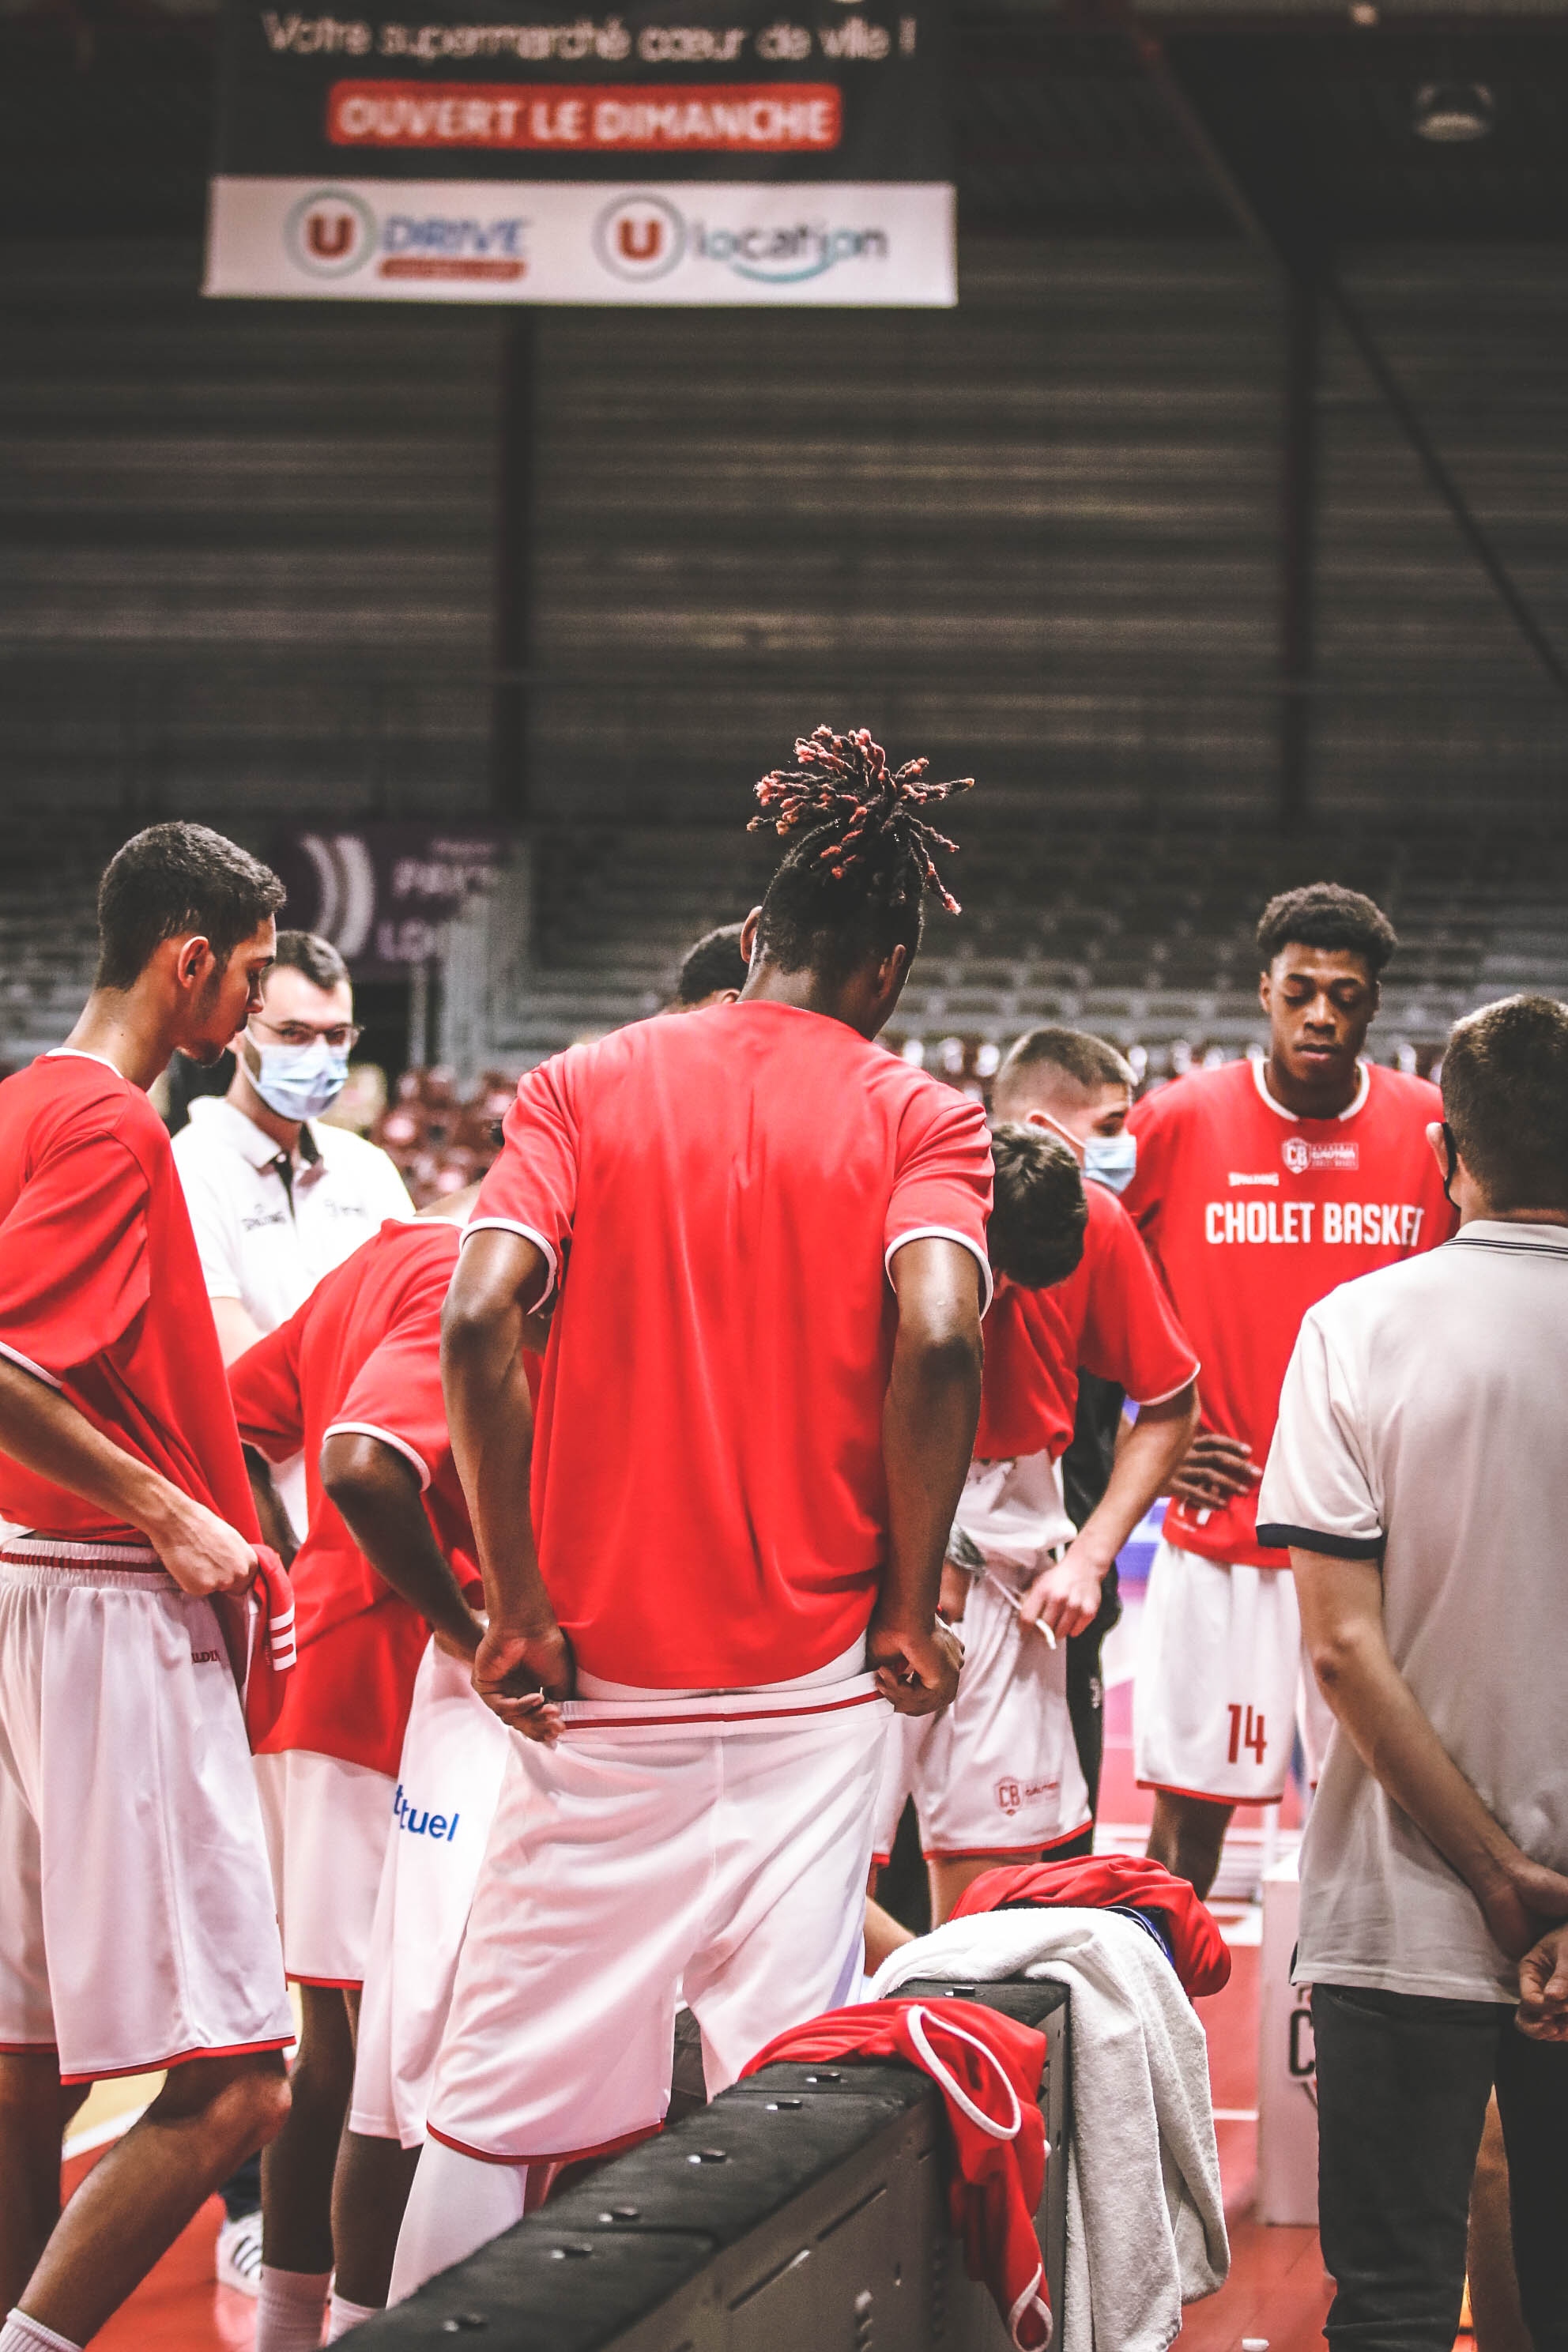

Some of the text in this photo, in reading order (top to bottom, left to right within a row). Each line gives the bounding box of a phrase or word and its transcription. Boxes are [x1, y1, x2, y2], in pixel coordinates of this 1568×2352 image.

[262, 9, 373, 55] Votre
[381, 19, 630, 66] supermarché
[756, 21, 812, 61] de
[818, 16, 891, 59] ville
[340, 95, 834, 143] OUVERT LE DIMANCHE
[307, 212, 528, 259] U DRIVE
[617, 217, 888, 273] U location
[1205, 1201, 1315, 1244] CHOLET
[1227, 1704, 1268, 1764] 14
